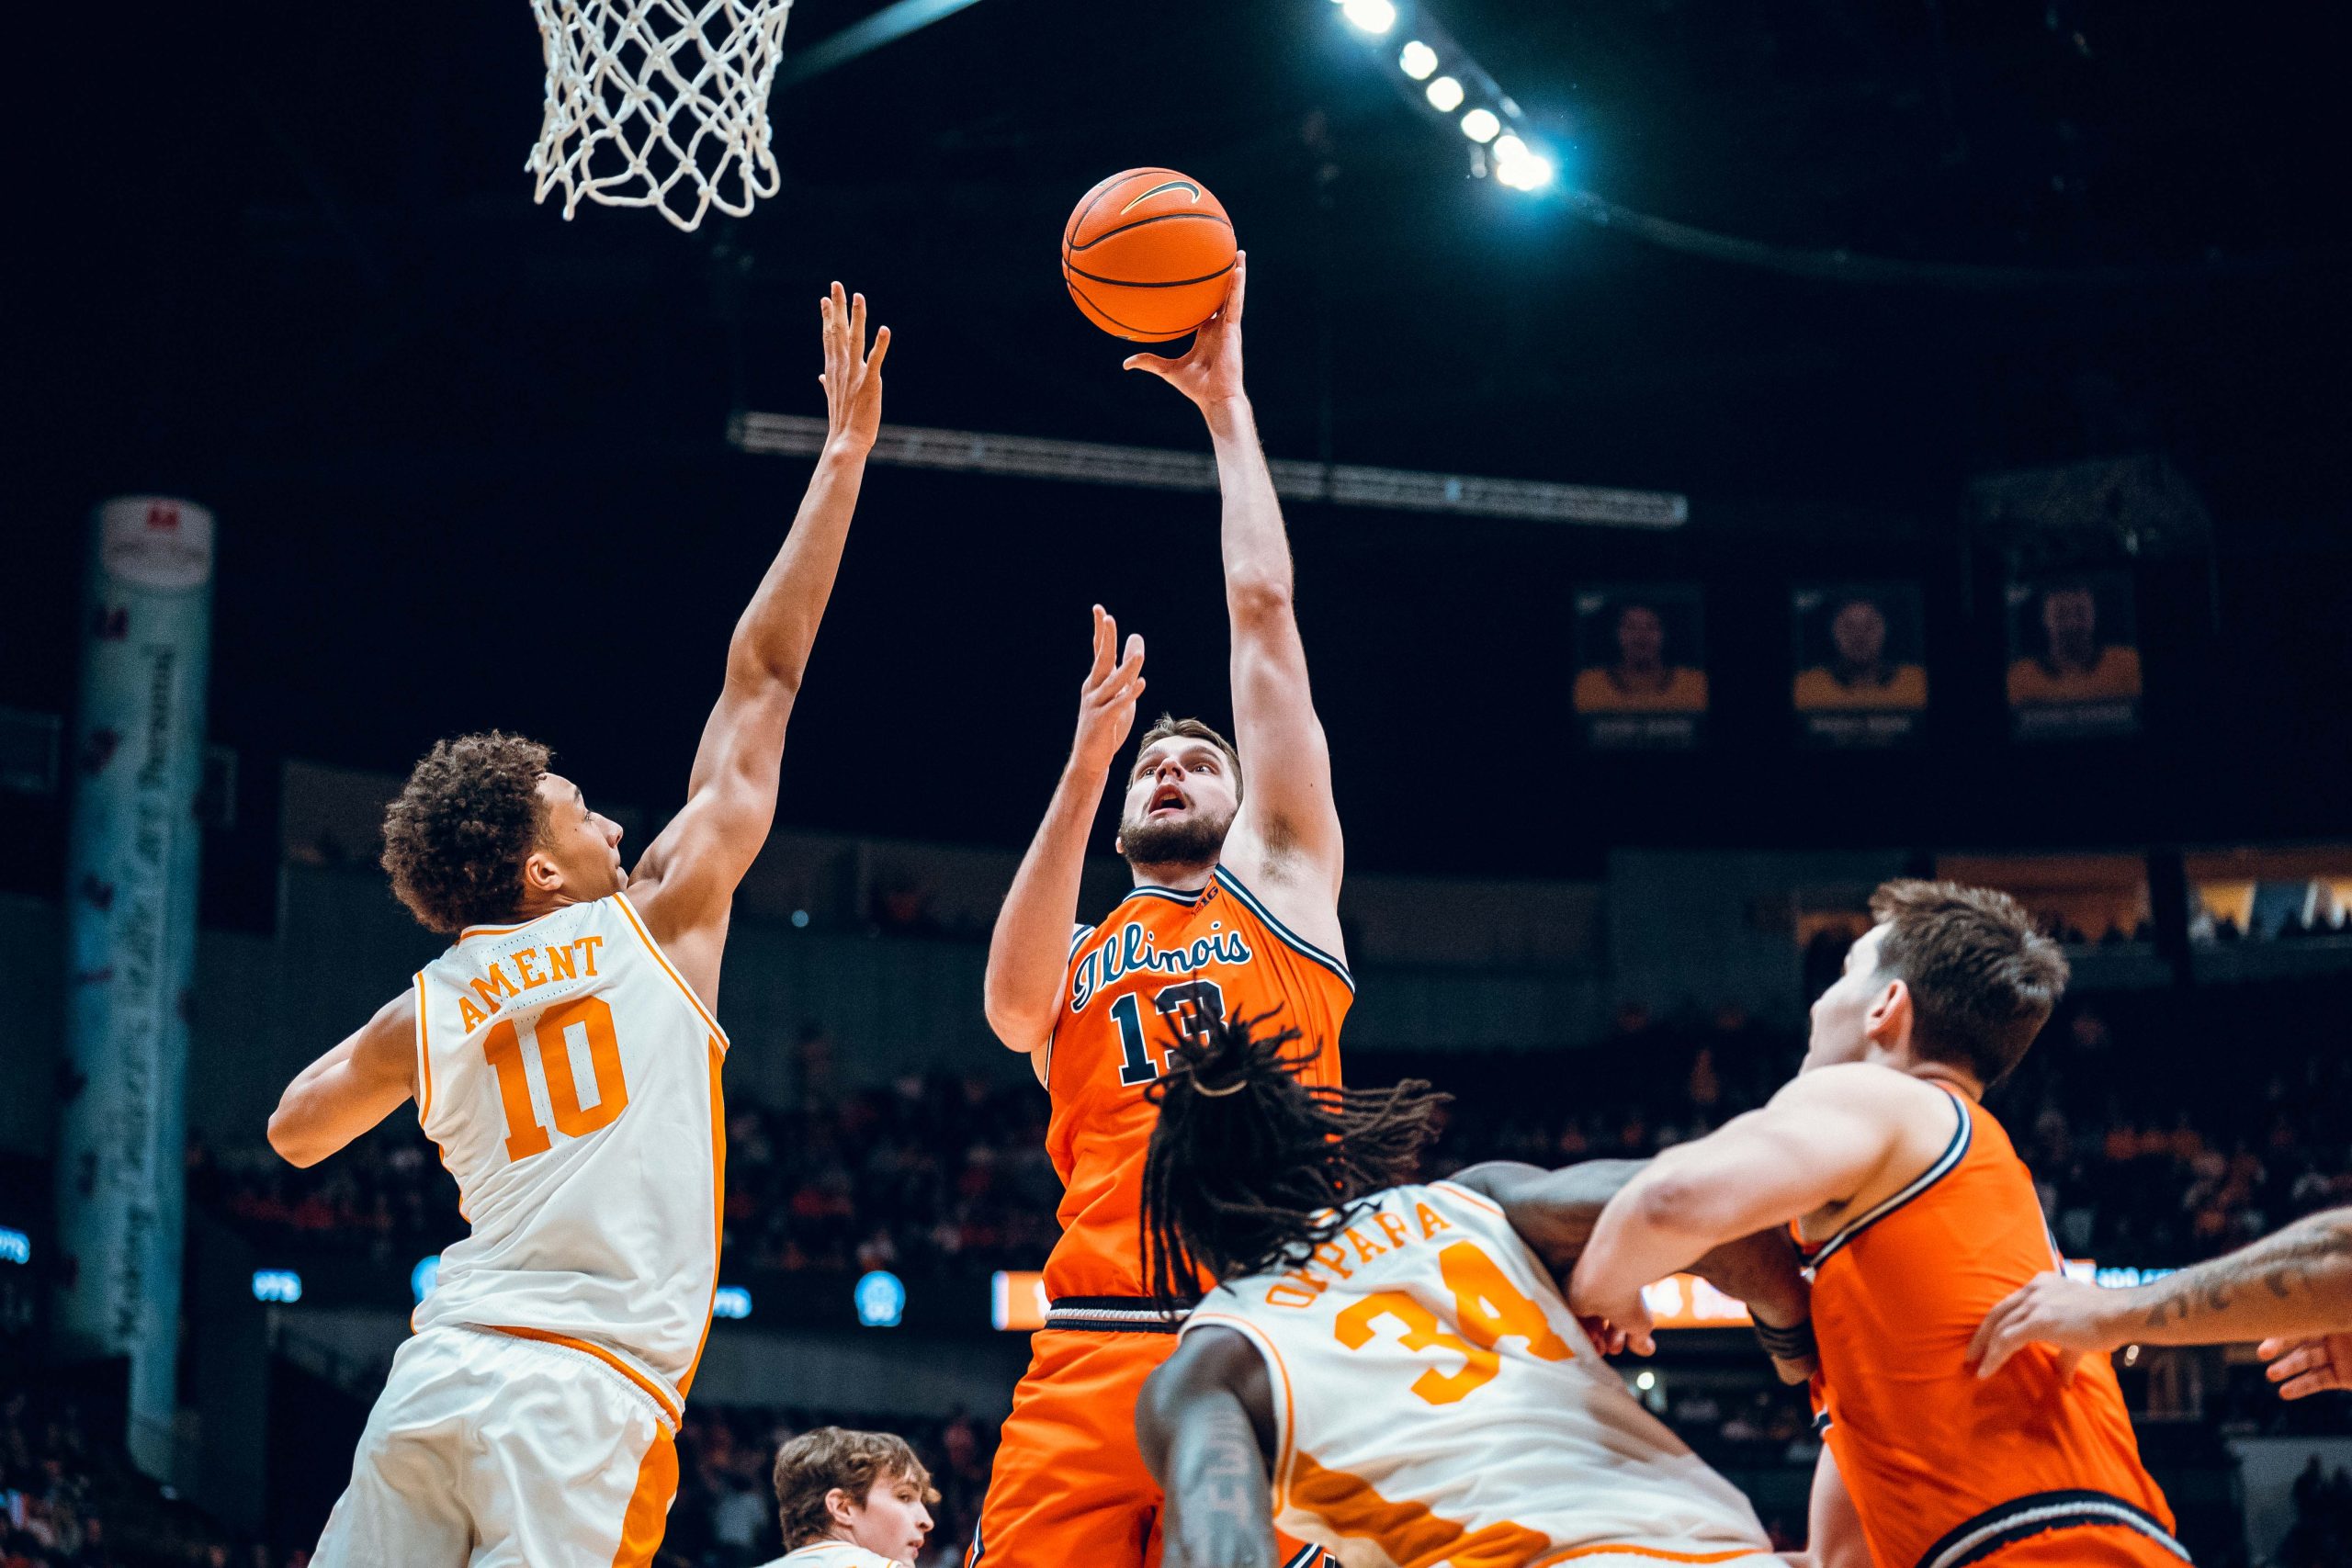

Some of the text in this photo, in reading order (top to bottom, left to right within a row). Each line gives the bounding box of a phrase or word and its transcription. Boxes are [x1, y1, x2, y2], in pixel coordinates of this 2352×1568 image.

[458, 935, 603, 1034] AMENT
[1071, 921, 1252, 1013] Illinois
[483, 995, 628, 1162] 10
[1335, 1240, 1576, 1405] 34
